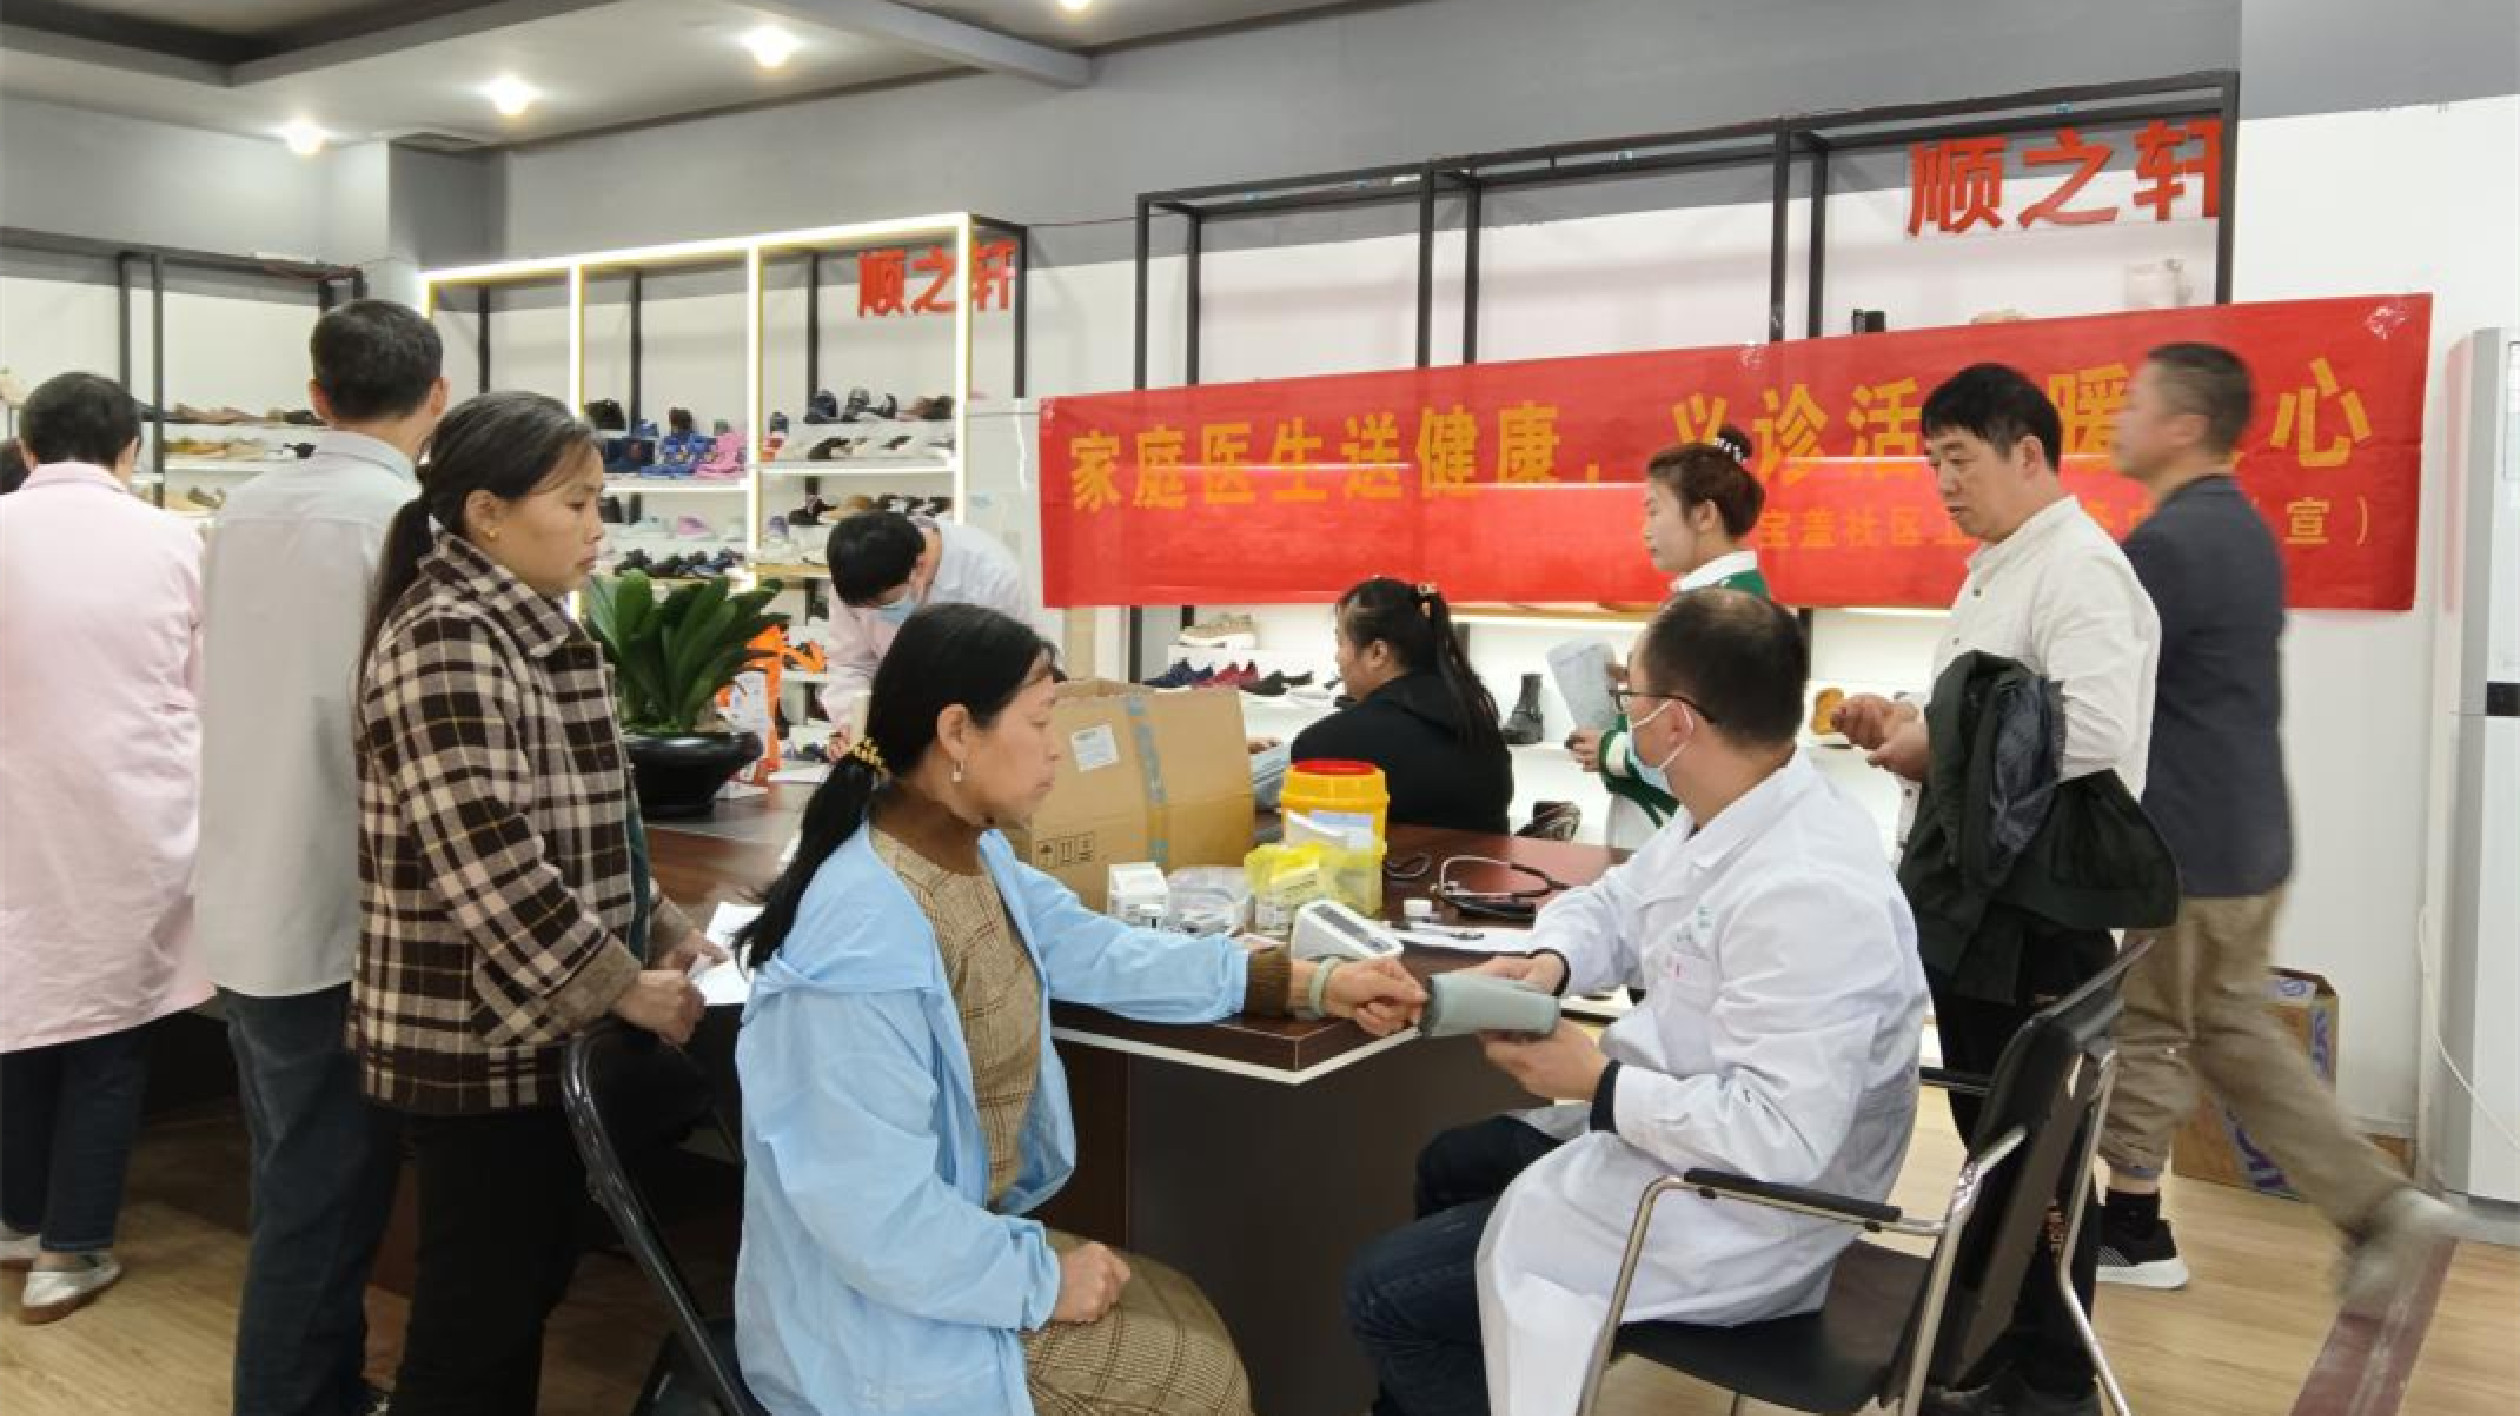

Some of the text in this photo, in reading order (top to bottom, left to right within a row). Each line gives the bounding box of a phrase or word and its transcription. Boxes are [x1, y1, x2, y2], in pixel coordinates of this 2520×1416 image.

[1908, 119, 2223, 236] 顺之轩
[857, 239, 1018, 318] 顺之轩
